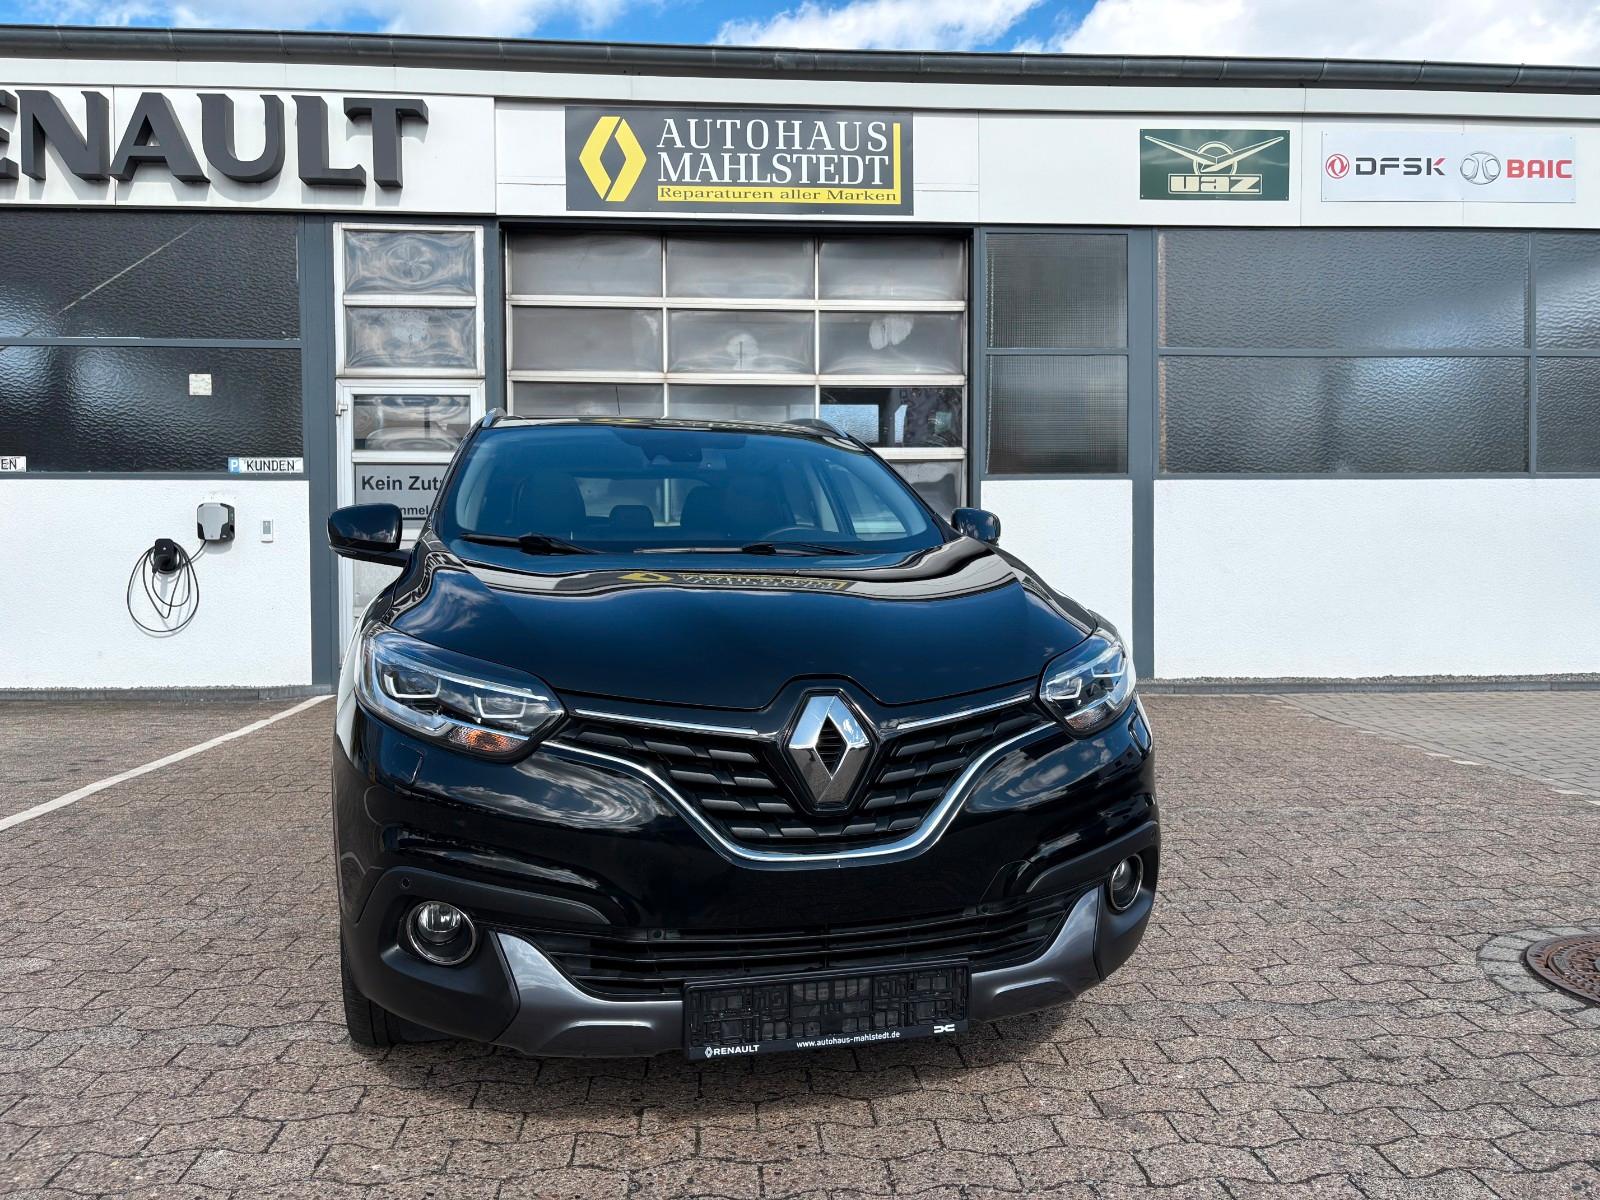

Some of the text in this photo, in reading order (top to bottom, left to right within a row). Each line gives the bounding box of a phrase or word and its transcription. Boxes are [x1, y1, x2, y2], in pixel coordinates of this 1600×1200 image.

[656, 118, 888, 152] AUTOHAUS
[657, 152, 889, 186] MAHLSTEDT
[1355, 157, 1446, 177] DFSK
[1506, 159, 1573, 179] BAIC
[660, 186, 897, 202] Reparaturen aller Marken
[246, 459, 295, 472] KUNDEN
[361, 475, 443, 491] Kein Zut
[796, 1030, 901, 1049] www.autohaus-mahlstedt.de
[713, 1044, 760, 1056] RENAULT
